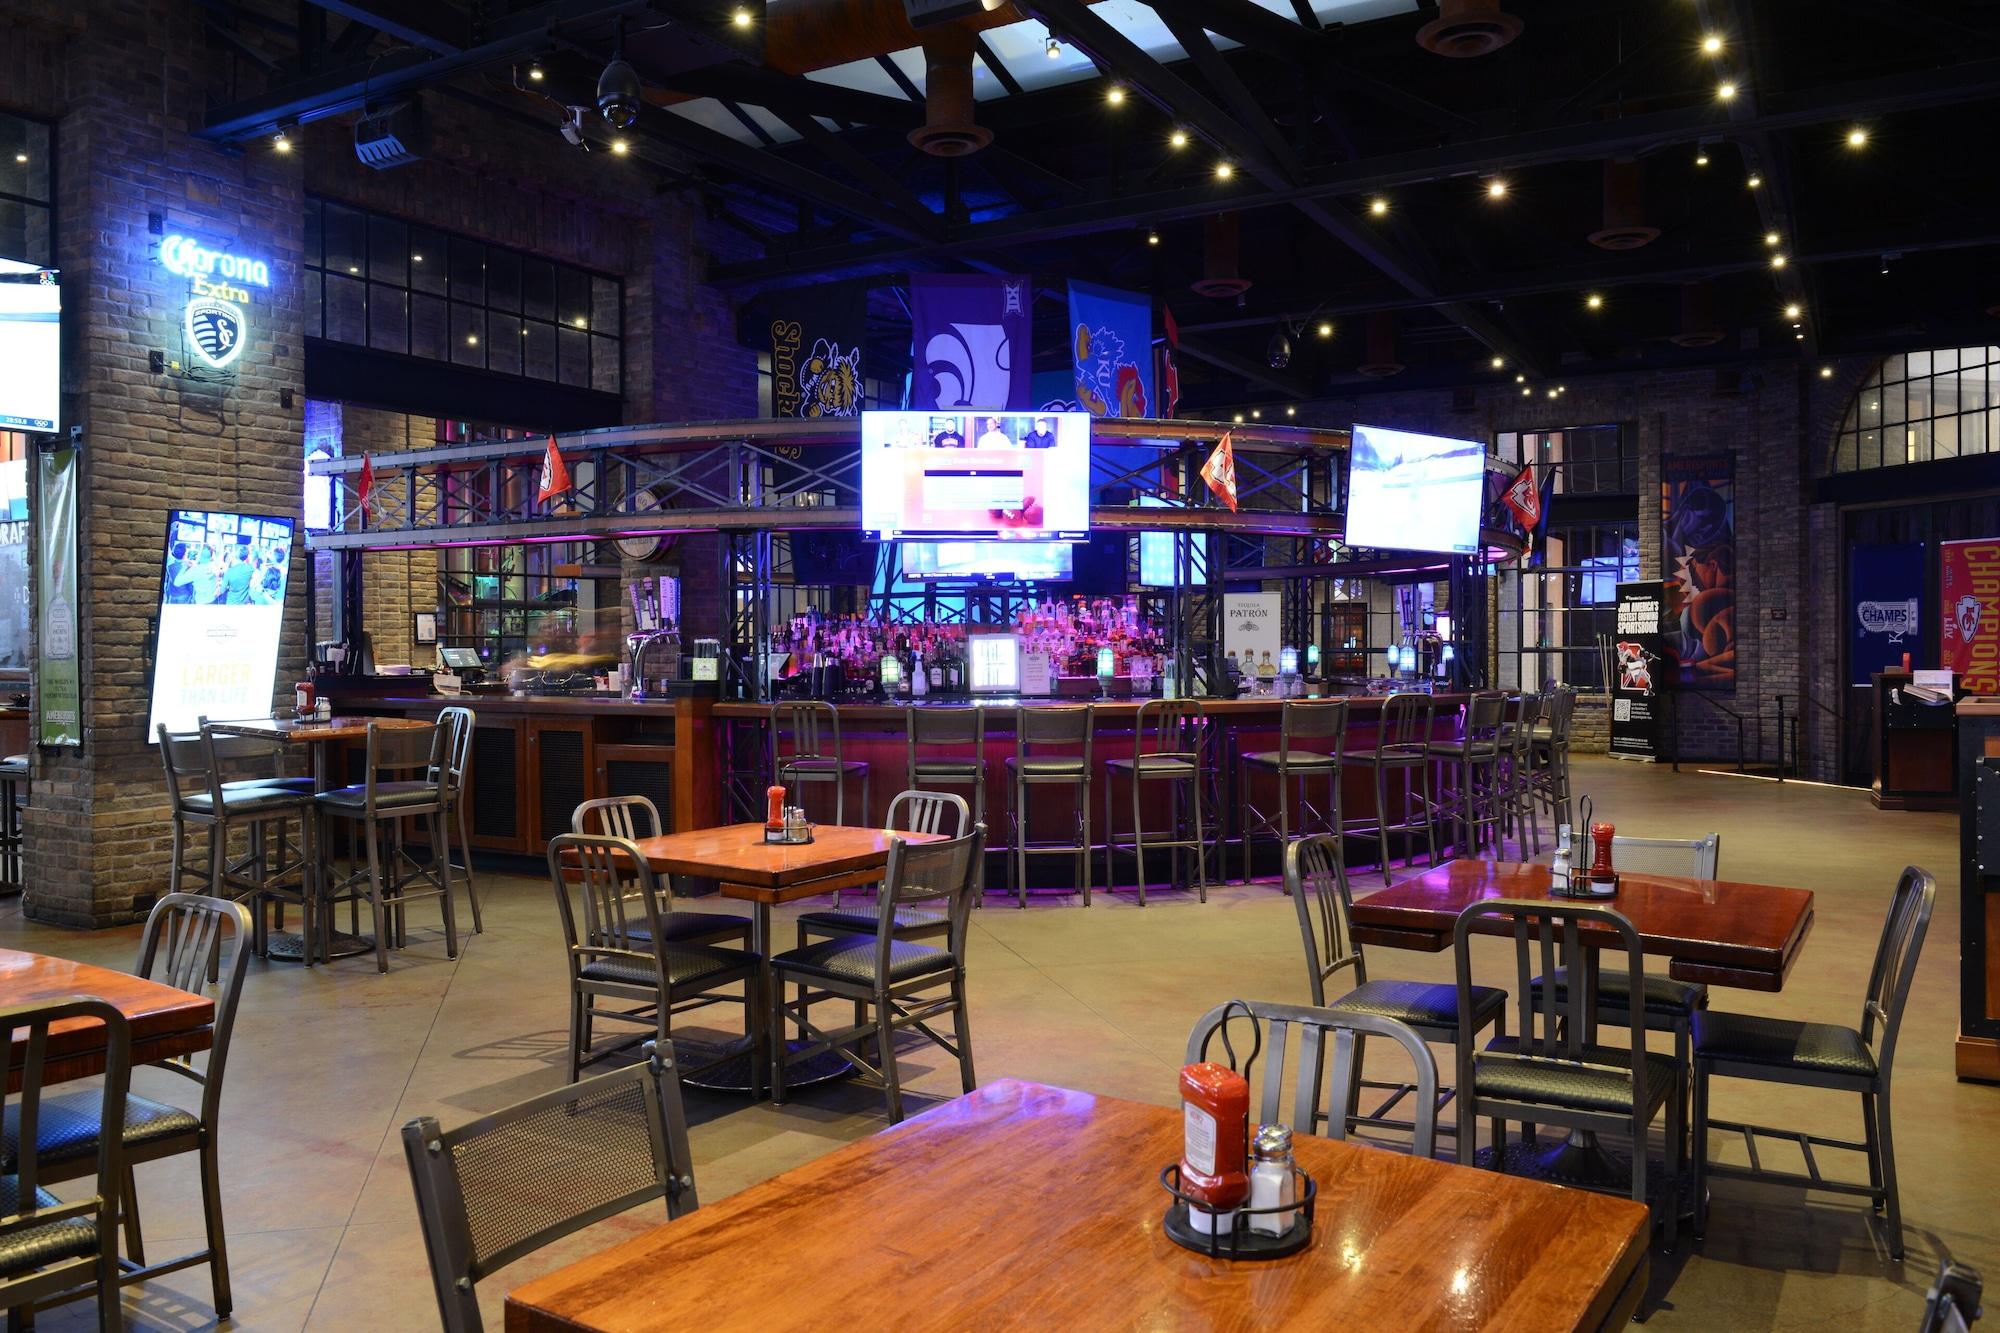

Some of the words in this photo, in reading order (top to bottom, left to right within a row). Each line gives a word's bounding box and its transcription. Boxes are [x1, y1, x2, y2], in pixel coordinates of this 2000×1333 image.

[161, 235, 269, 287] Corona
[192, 272, 249, 304] Extra
[194, 308, 237, 324] SPORTING
[1097, 360, 1110, 388] KU
[1230, 607, 1268, 618] PATRÓN
[1617, 602, 1631, 612] JOIN
[1631, 600, 1660, 612] AMERICA'S
[1618, 612, 1637, 621] FASTEST
[1862, 609, 1907, 623] CHAMPS
[1960, 546, 2000, 693] CHAMPIONS
[1617, 621, 1659, 634] SPORTSBOOK
[182, 663, 252, 687] LARGER
[181, 688, 216, 704] THAN
[221, 686, 249, 704] LIFE
